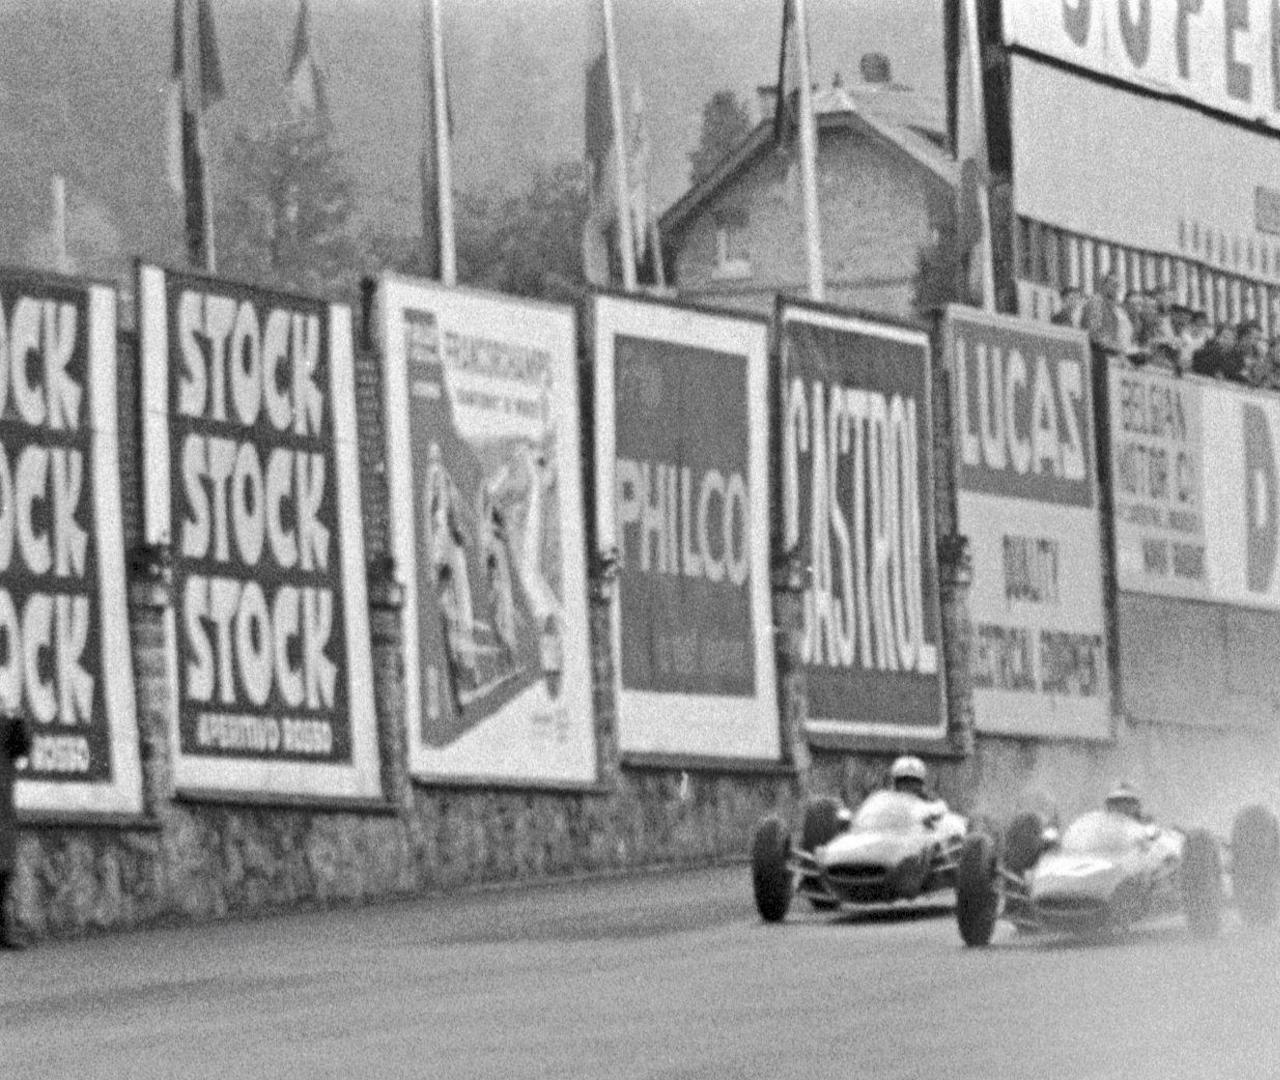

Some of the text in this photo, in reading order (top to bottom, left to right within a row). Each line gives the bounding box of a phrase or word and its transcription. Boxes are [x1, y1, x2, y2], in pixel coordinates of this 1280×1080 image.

[0, 295, 82, 430] CK
[178, 290, 323, 438] STOCK
[956, 338, 1087, 482] LUCAS
[182, 433, 330, 573] STOCK
[616, 457, 750, 586] PHILCO
[783, 378, 938, 675] CASTROL
[183, 575, 337, 710] STOCK
